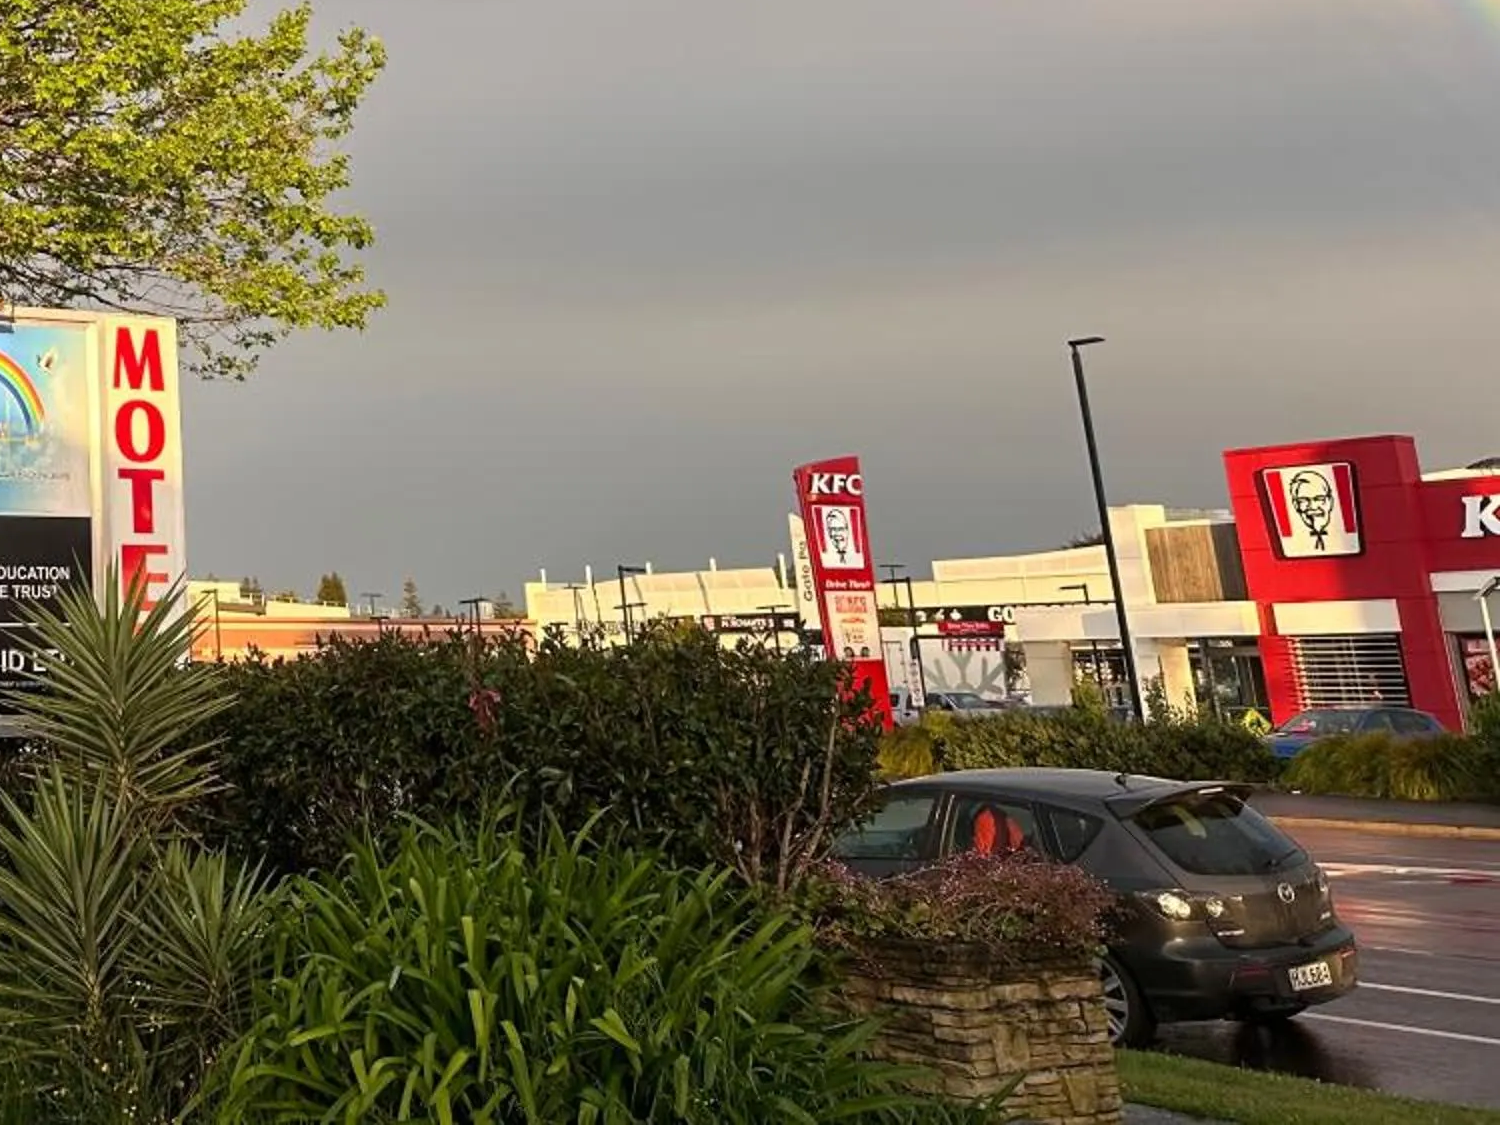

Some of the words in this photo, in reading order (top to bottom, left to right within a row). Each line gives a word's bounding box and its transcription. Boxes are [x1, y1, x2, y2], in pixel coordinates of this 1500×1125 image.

[113, 327, 169, 633] MOTE
[810, 473, 864, 495] KFC
[0, 650, 25, 672] ID
